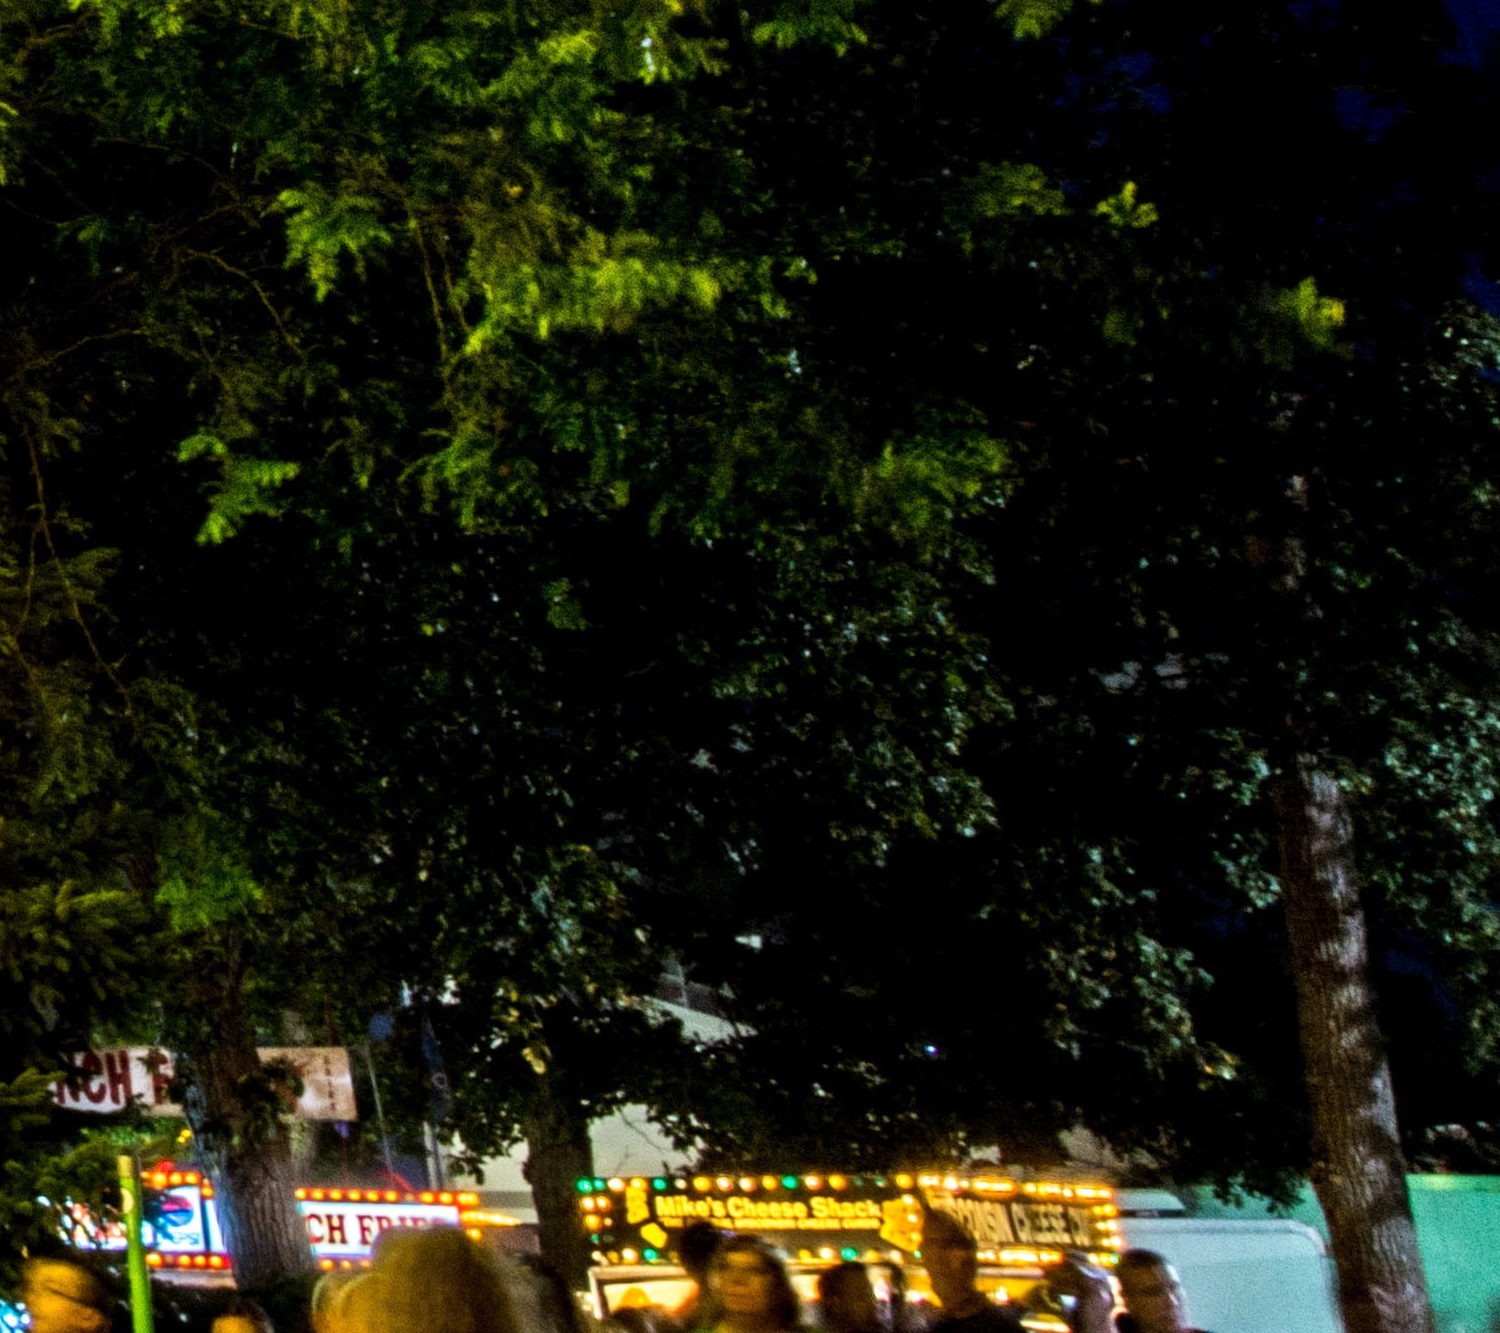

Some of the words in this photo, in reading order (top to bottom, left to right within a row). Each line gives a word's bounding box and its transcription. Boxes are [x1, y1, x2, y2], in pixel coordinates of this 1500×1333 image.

[655, 1195, 726, 1218] Mike's
[727, 1196, 808, 1218] Cheese
[810, 1196, 882, 1218] Shack
[305, 1213, 348, 1245] CH
